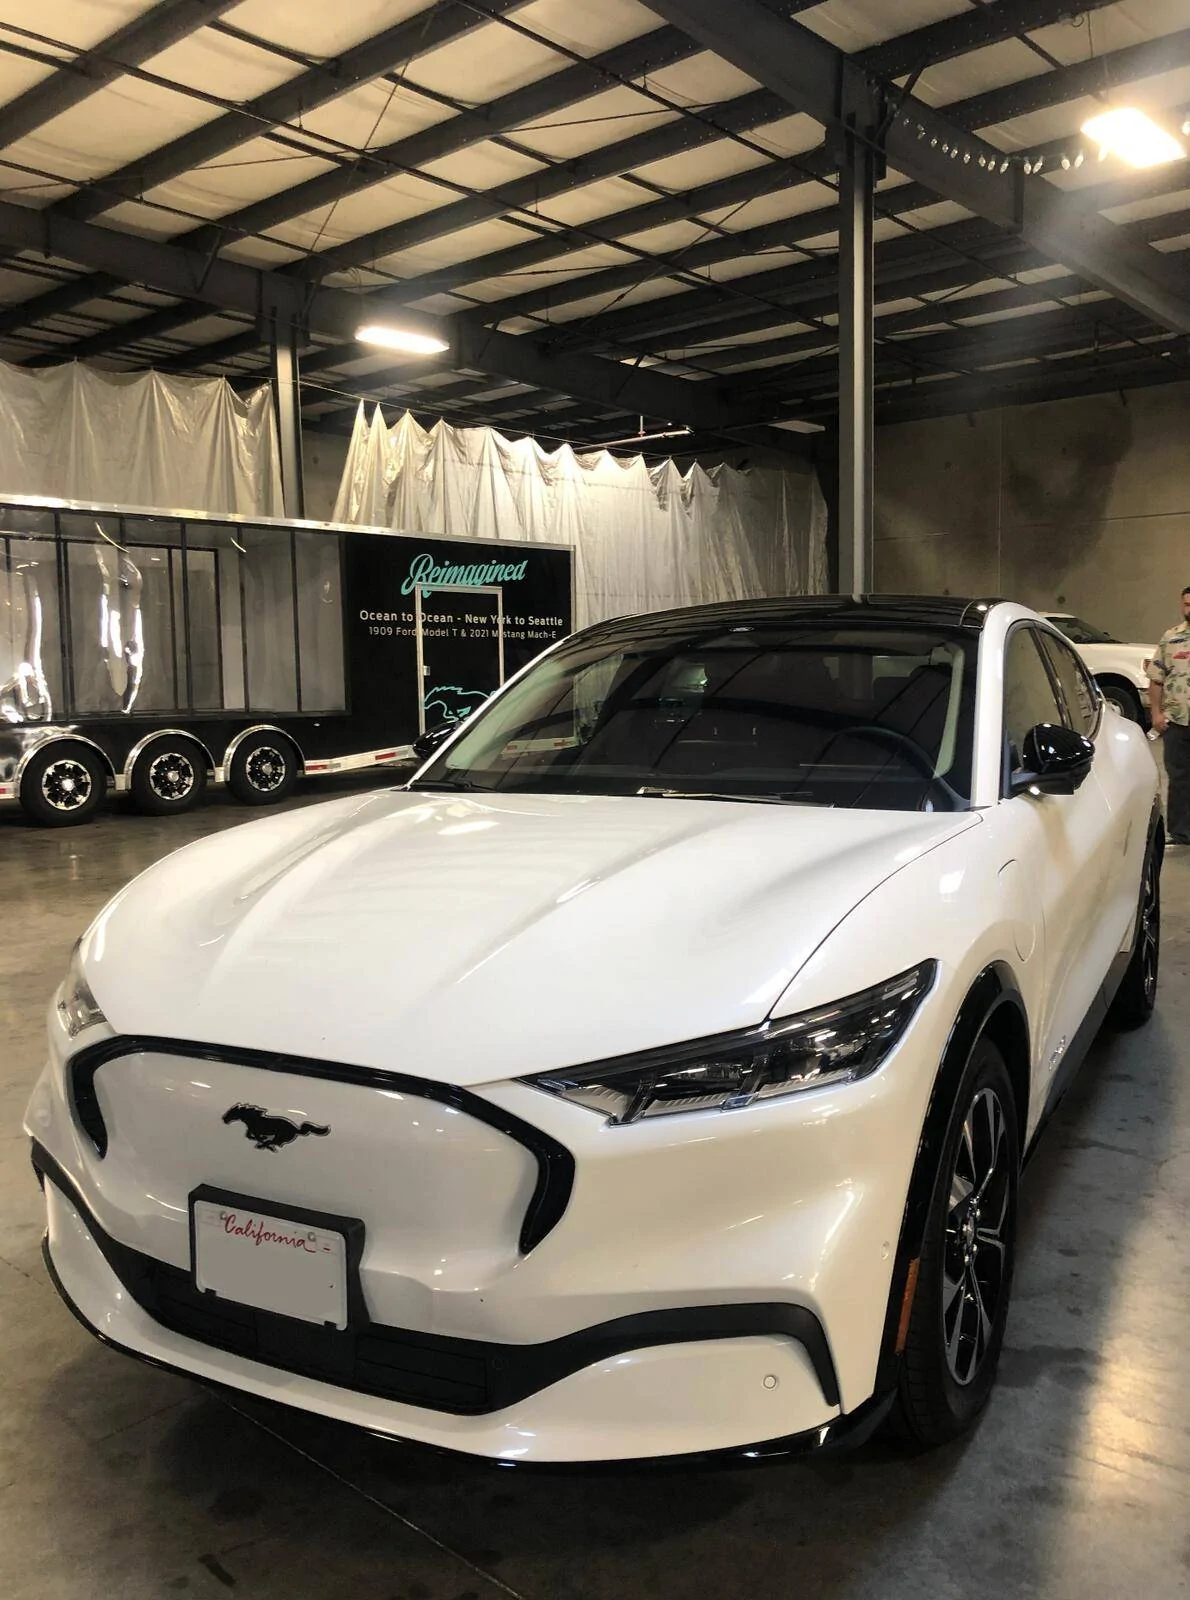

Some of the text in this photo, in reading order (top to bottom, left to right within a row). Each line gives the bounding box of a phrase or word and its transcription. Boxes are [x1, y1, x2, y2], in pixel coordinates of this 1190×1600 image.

[401, 553, 528, 598] Reimagined
[360, 610, 398, 622] Ocean
[401, 612, 414, 622] to
[418, 612, 454, 623] Ocean
[465, 614, 488, 624] New
[490, 615, 512, 625] York
[514, 616, 525, 625] to
[528, 616, 563, 626] Seattle
[368, 626, 393, 636] 1909
[422, 628, 449, 637] Model
[452, 628, 458, 637] T
[460, 628, 467, 638] &
[470, 629, 489, 638] 2021
[491, 629, 525, 640] Mstang
[527, 630, 557, 639] Mach-E
[224, 1214, 316, 1254] California
